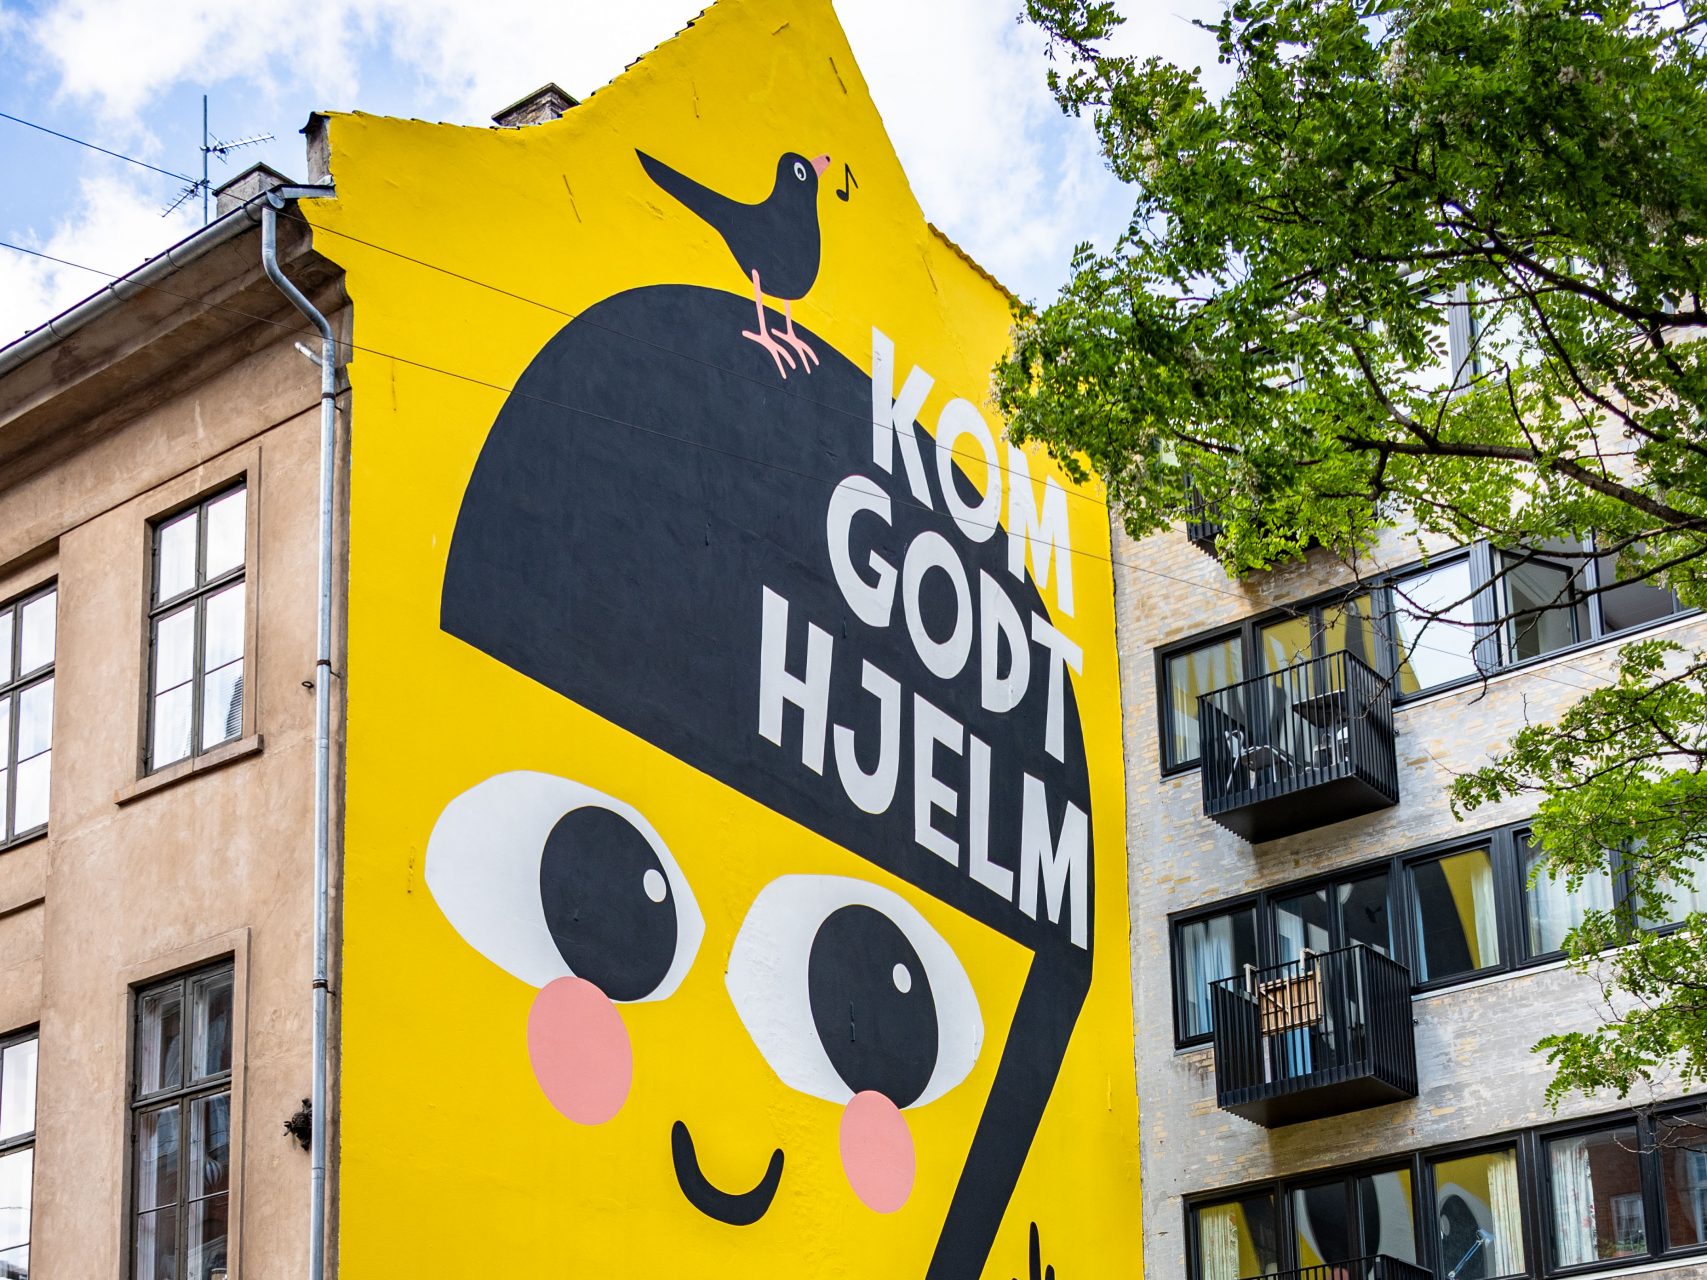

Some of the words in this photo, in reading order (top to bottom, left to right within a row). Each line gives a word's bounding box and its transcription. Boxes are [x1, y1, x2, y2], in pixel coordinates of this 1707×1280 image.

[872, 326, 1074, 618] KOM
[827, 475, 1083, 763] GODT
[759, 585, 1088, 950] HJELM
